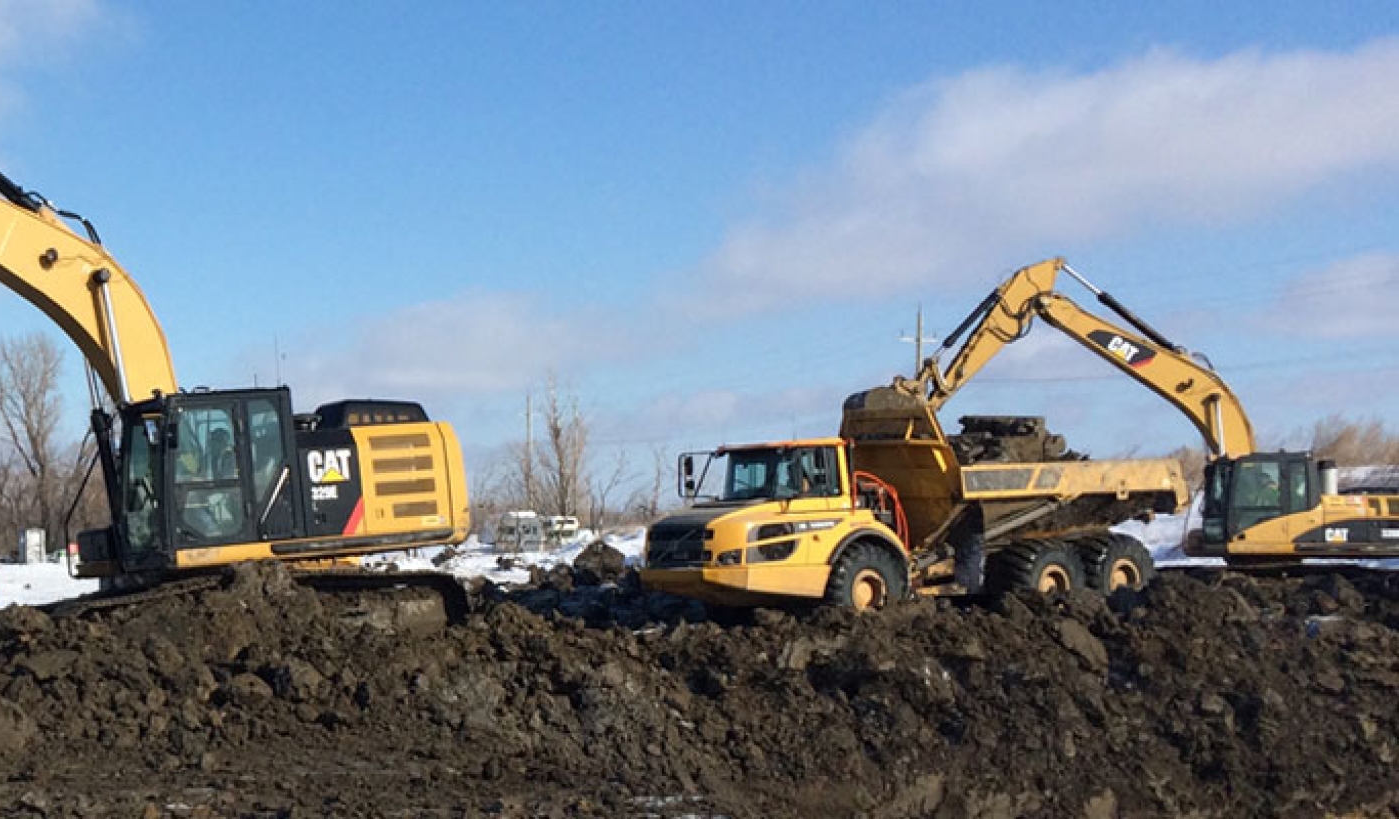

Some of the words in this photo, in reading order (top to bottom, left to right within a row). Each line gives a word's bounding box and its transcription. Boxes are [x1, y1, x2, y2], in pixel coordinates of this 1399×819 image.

[1107, 335, 1140, 362] CAT
[307, 448, 351, 483] CAT
[1324, 527, 1349, 544] CAT
